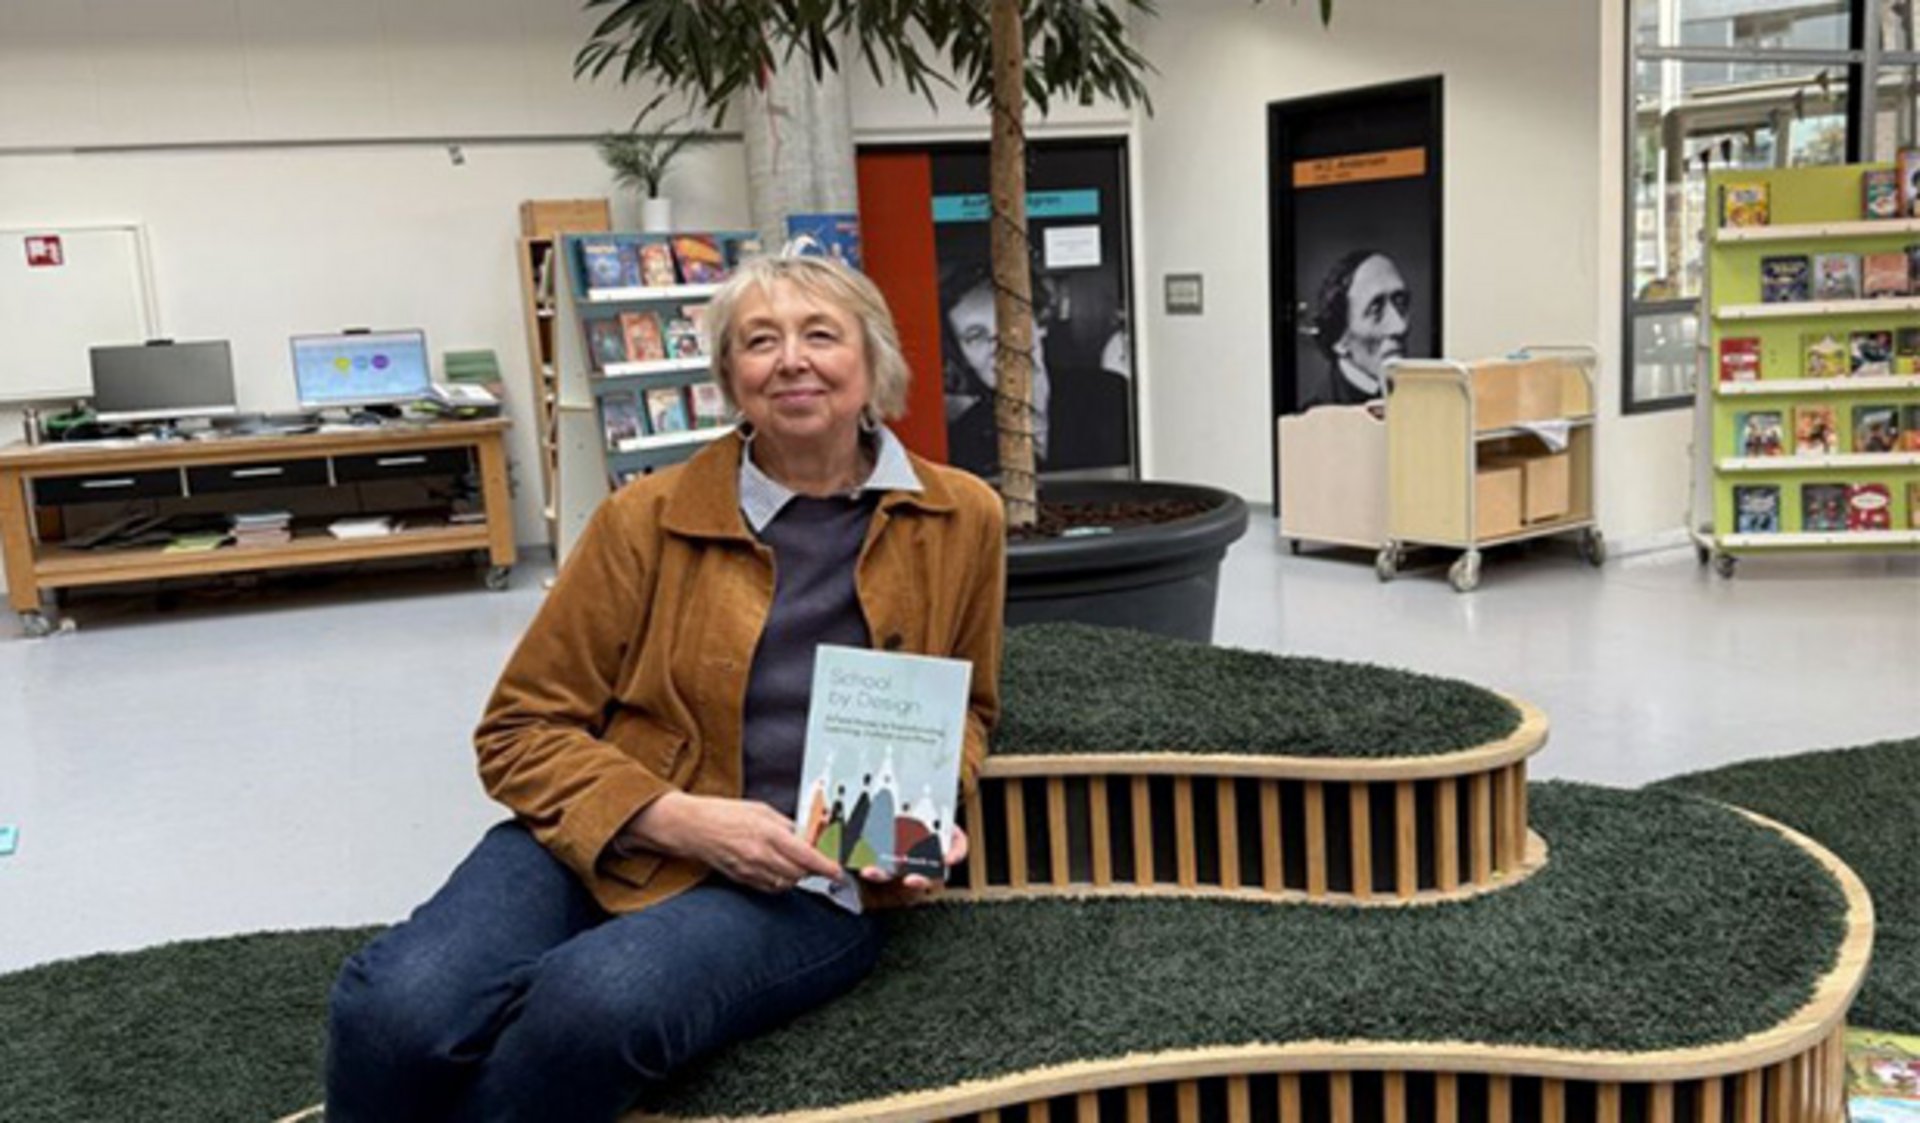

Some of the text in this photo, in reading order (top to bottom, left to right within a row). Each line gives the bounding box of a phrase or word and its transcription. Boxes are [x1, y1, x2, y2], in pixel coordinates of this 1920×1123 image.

[830, 667, 892, 690] School
[828, 690, 922, 717] by Design
